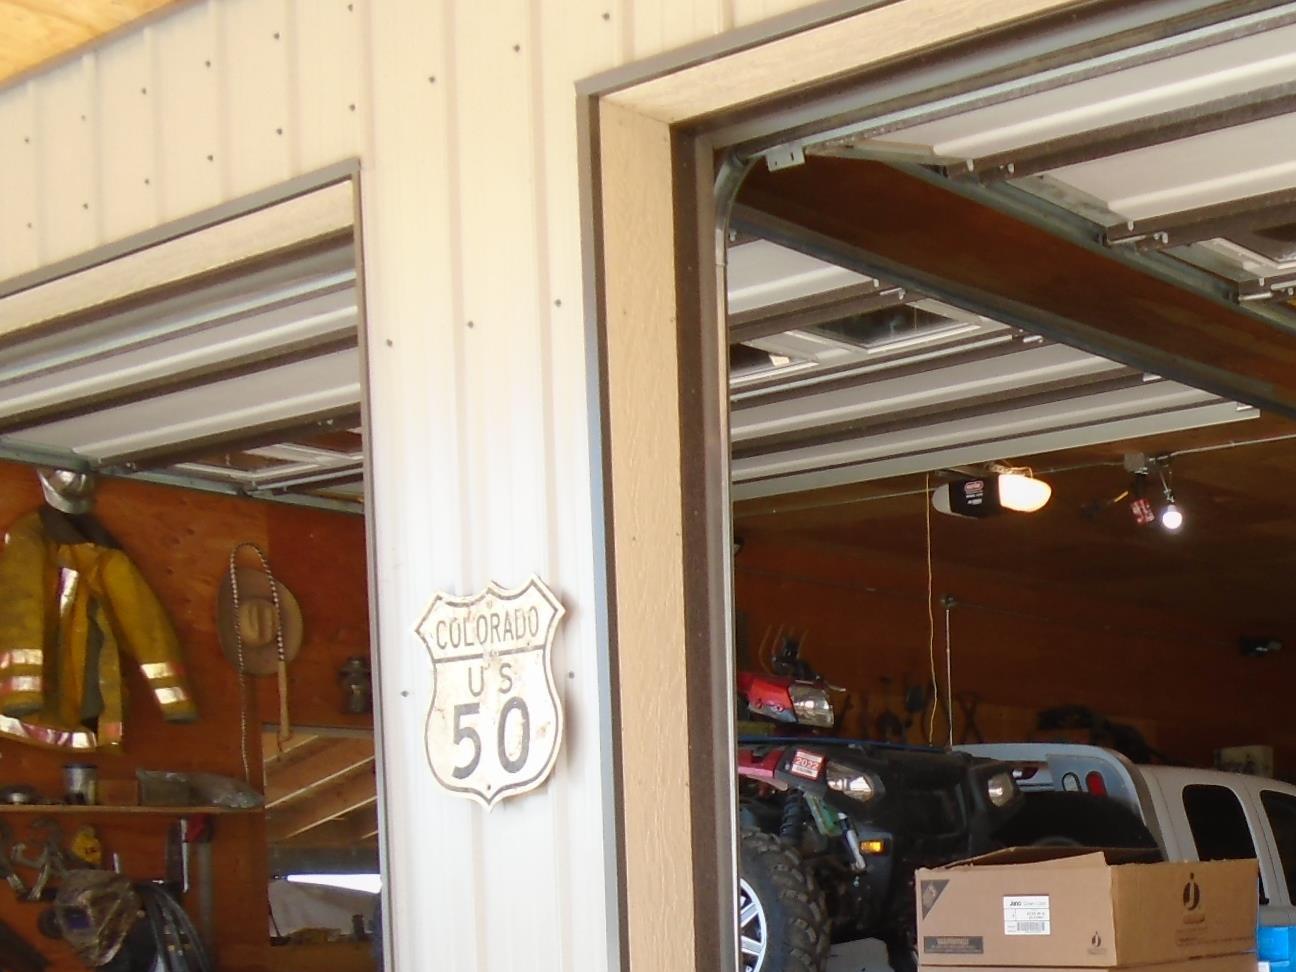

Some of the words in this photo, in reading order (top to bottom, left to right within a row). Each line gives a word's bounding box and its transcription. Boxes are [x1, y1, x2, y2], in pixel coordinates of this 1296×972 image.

[436, 606, 539, 649] COLORADO
[452, 697, 531, 780] 50
[794, 757, 819, 769] 2022
